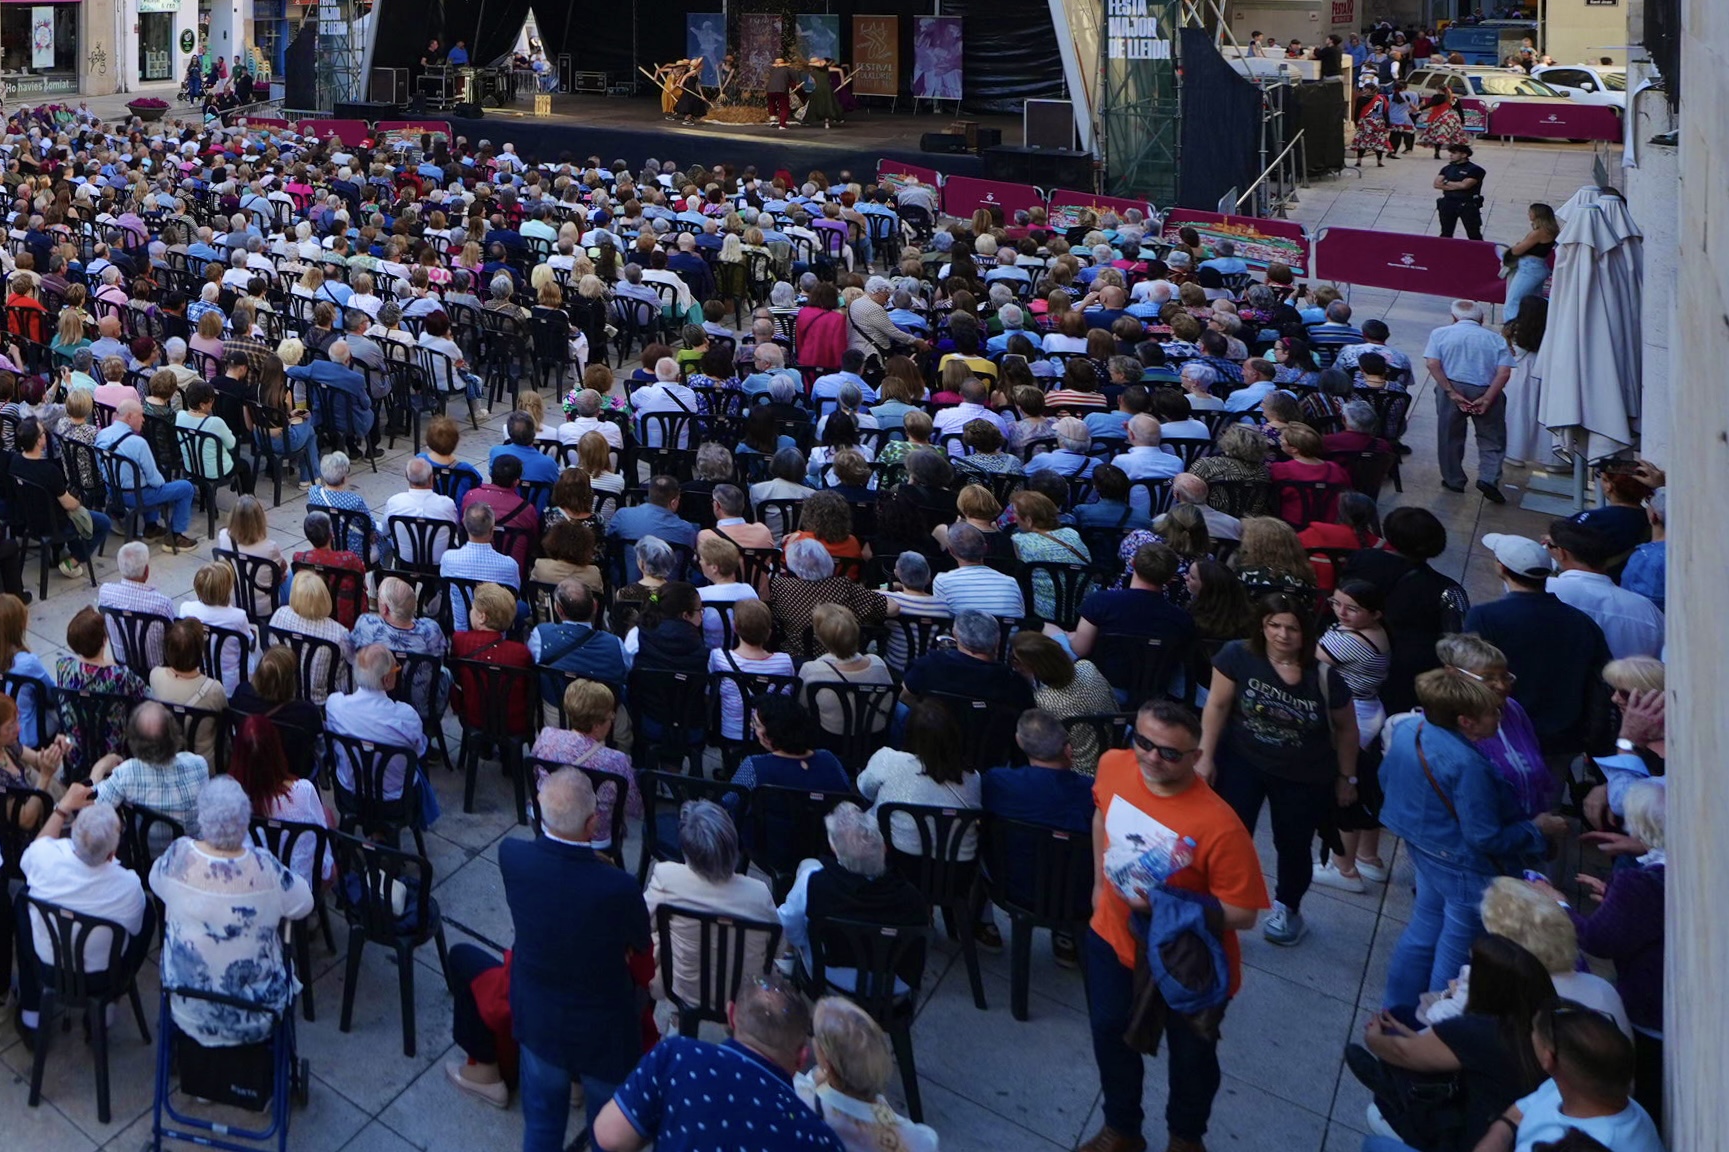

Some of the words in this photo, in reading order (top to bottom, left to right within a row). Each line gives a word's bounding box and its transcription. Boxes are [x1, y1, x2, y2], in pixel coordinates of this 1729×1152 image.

[1108, 17, 1158, 38] MAJOR
[1108, 39, 1126, 59] DE
[1127, 39, 1171, 59] LLEIDA
